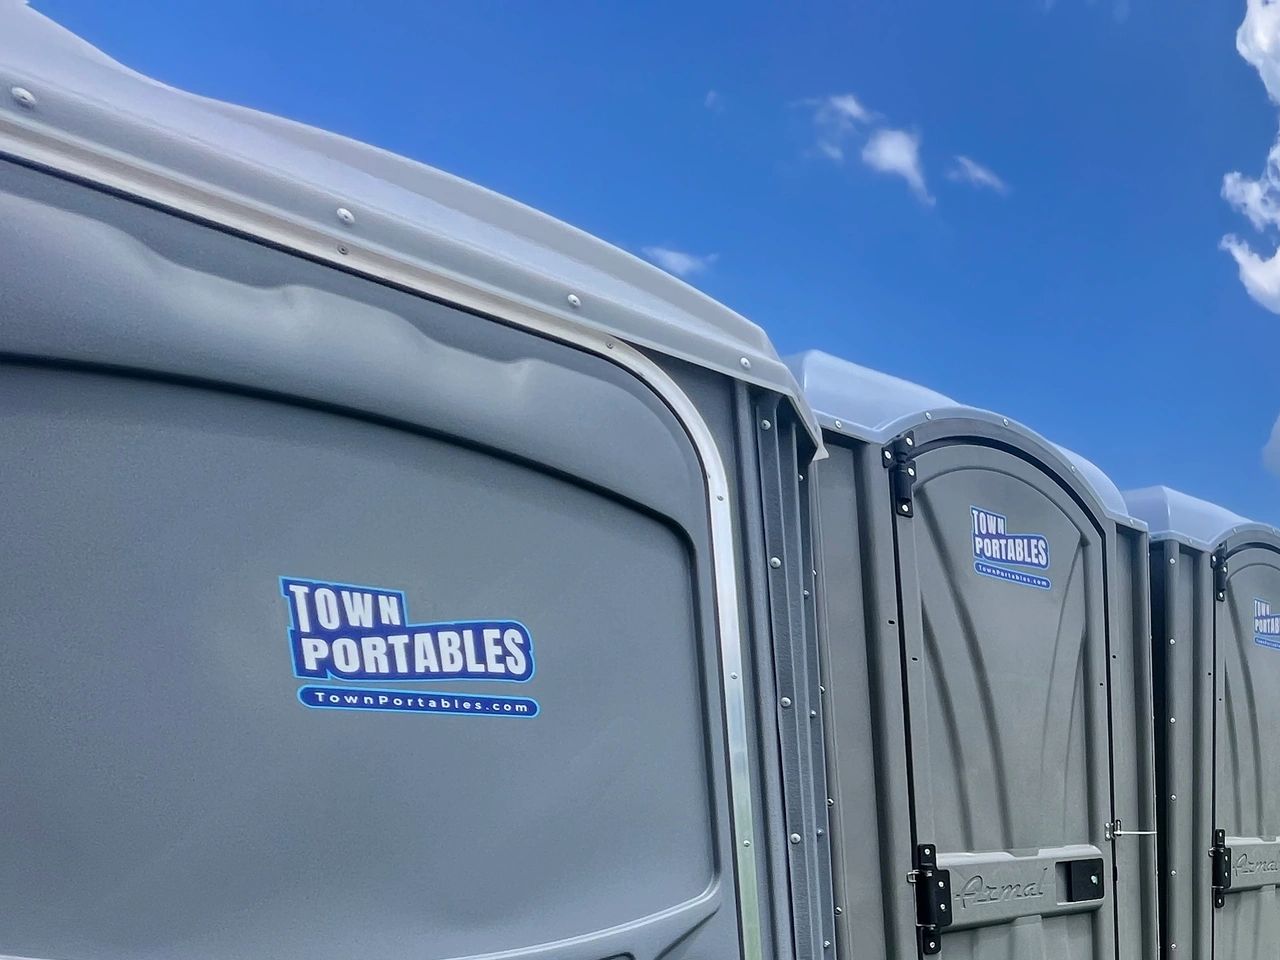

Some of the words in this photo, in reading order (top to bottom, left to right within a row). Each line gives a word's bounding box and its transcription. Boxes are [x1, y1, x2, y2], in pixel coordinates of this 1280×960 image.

[972, 509, 1005, 535] TOWN
[974, 537, 1047, 566] PORTABLES
[289, 584, 401, 633] TOWN
[301, 628, 527, 675] PORTABLES
[314, 691, 528, 713] TownPortables.com
